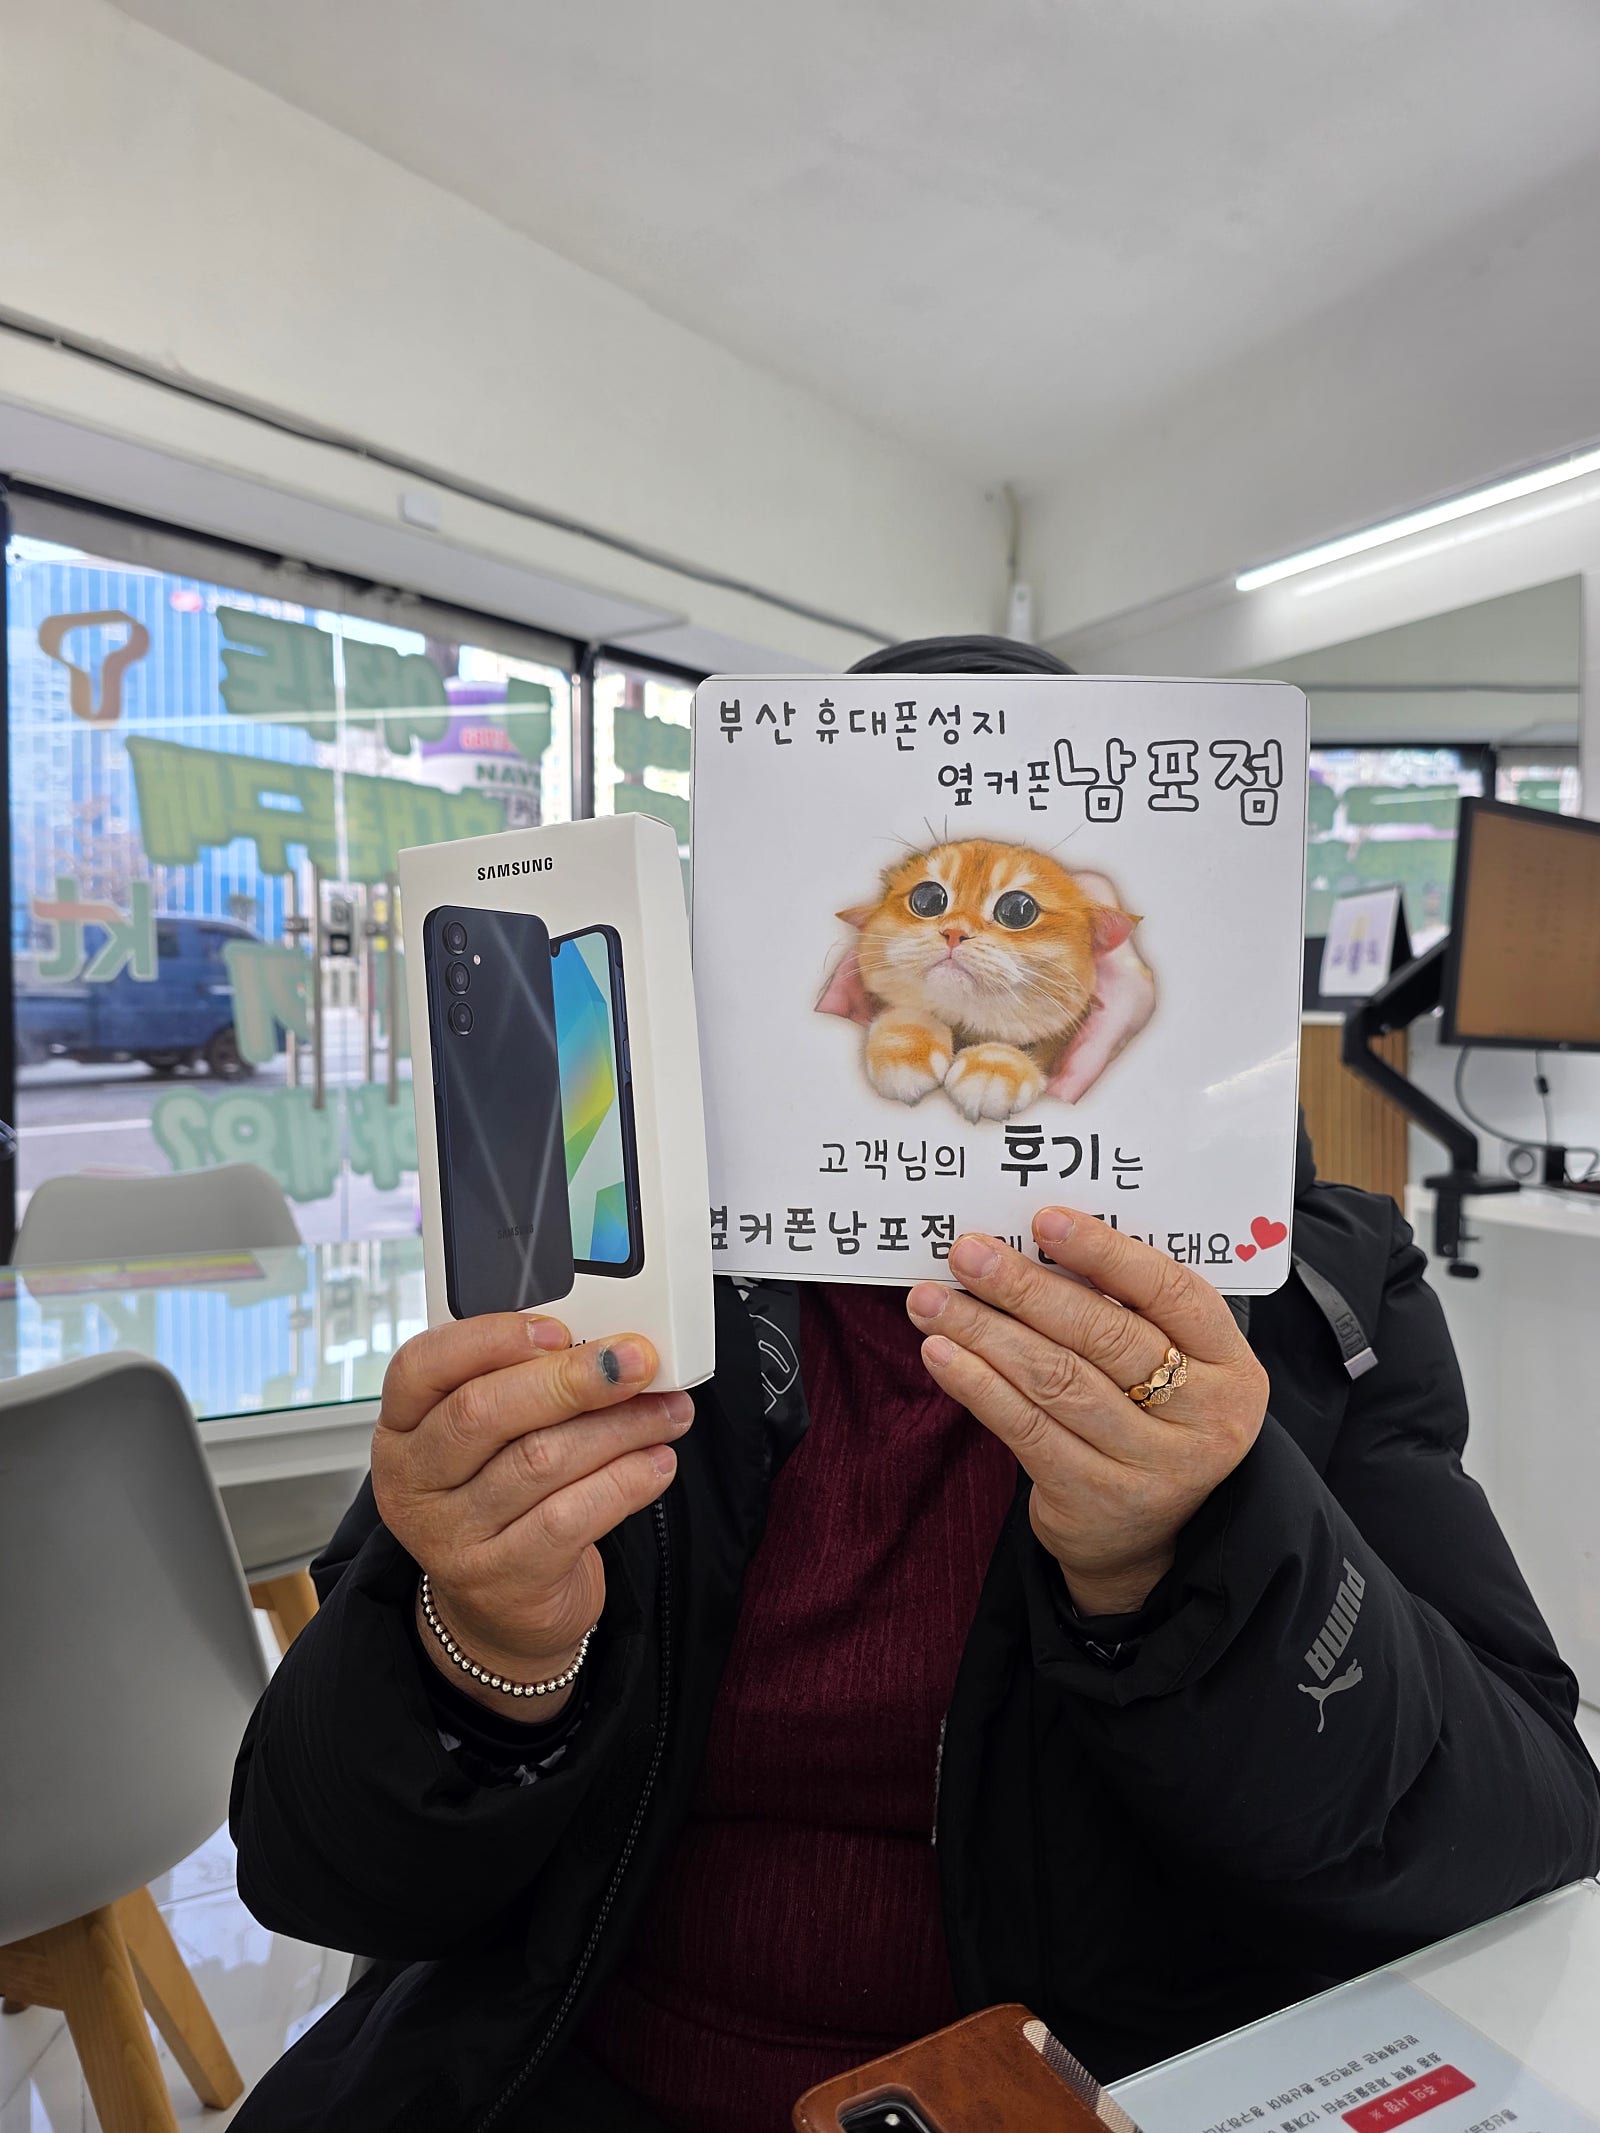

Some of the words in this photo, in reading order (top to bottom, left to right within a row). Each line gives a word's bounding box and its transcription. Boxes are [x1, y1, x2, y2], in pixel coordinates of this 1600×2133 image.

[720, 699, 796, 745] 부산
[477, 857, 553, 881] SAMSUNG
[819, 1139, 965, 1182] 고객님의
[1001, 1124, 1144, 1190] 후기는
[1167, 1232, 1233, 1265] 돼요
[1304, 1557, 1366, 1681] PUMA
[1314, 2060, 1364, 2087] 금액으로
[1382, 2097, 1410, 2115] 사항
[1408, 2084, 1438, 2102] 주의
